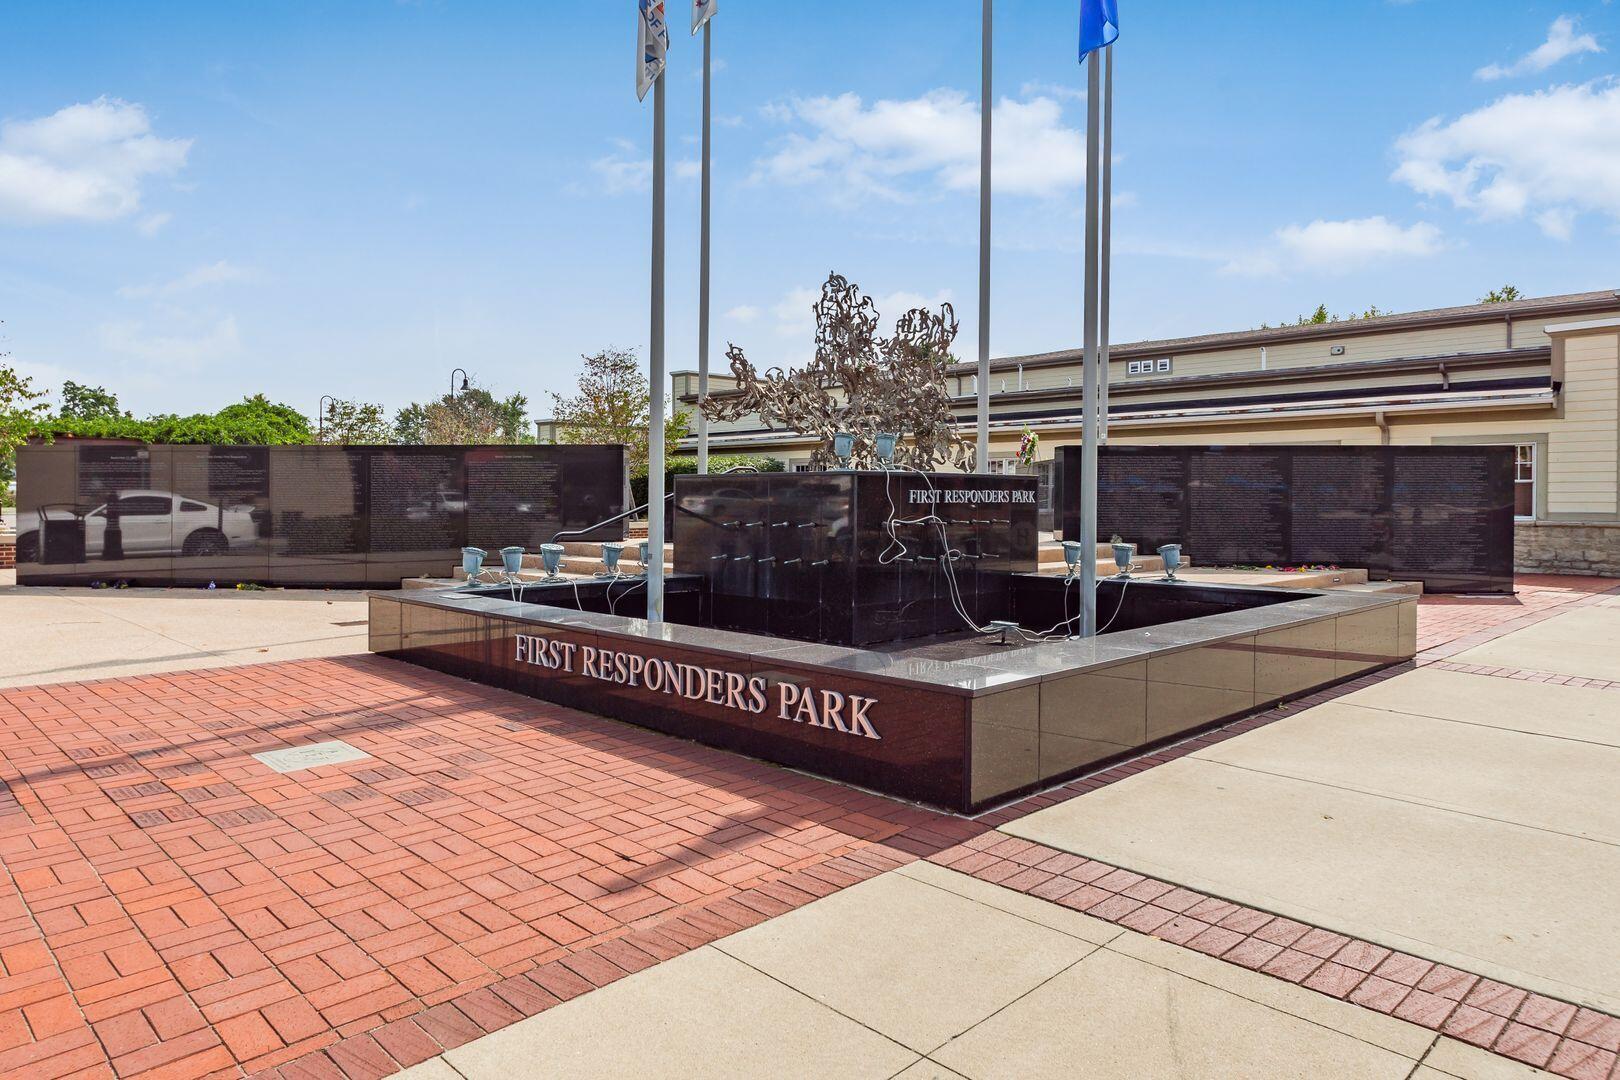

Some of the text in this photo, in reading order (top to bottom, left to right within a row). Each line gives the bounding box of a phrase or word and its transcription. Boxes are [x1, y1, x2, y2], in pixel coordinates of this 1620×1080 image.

[909, 489, 1036, 504] FIRST RESPONDERS PARK
[515, 633, 882, 740] FIRST RESPONDERS PARK
